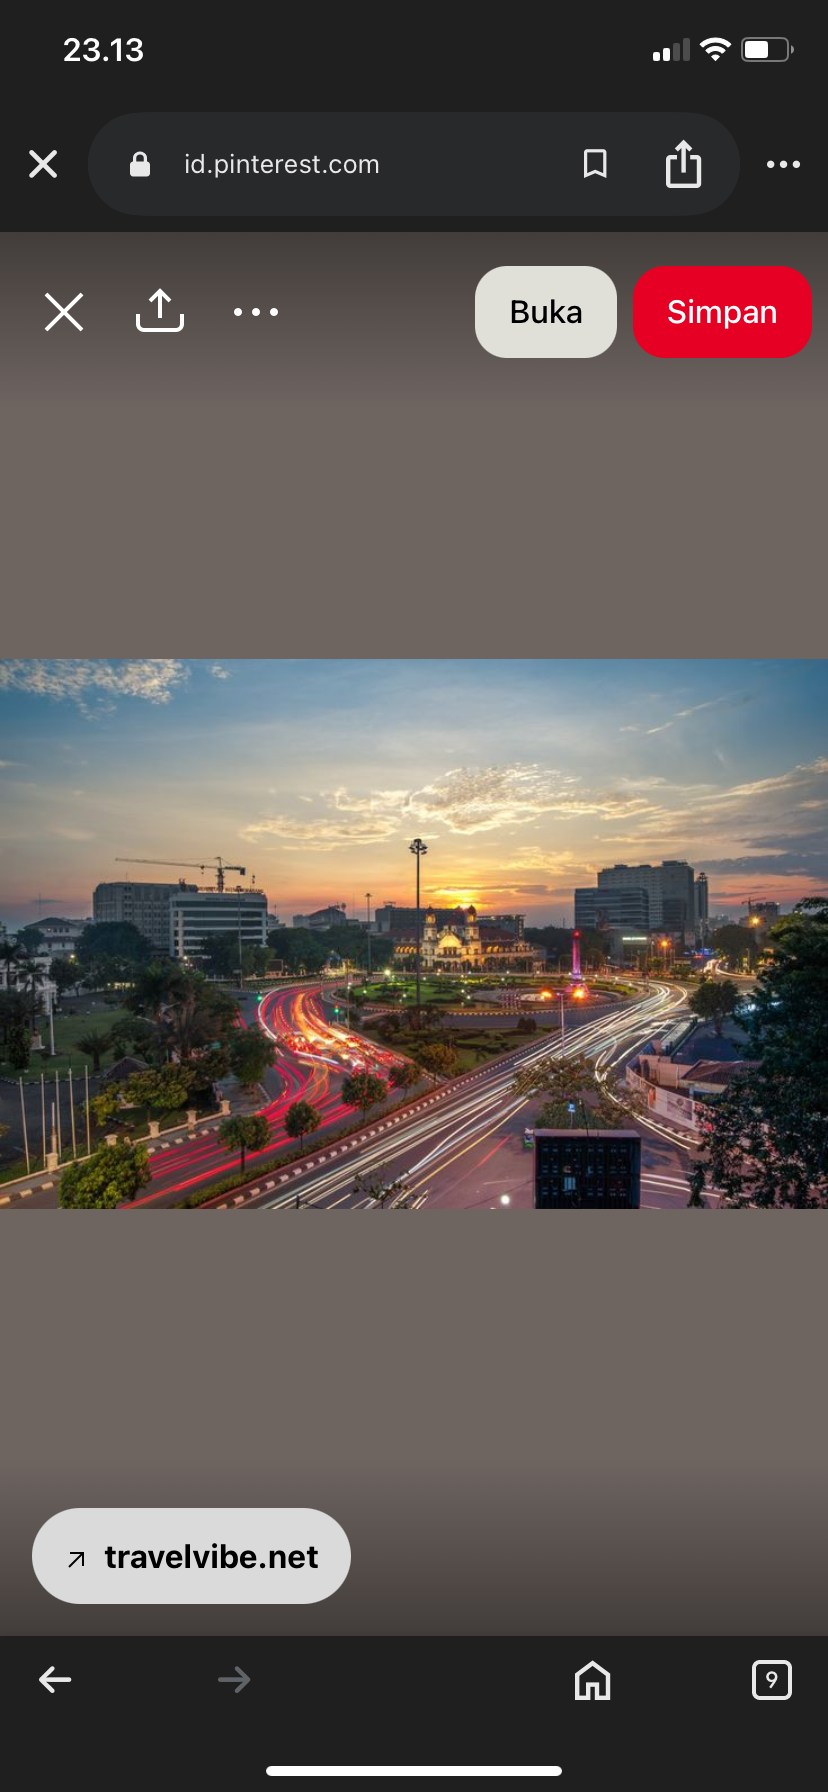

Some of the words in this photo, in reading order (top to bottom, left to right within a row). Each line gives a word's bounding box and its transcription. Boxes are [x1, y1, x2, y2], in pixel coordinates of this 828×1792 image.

[64, 38, 143, 62] 23.13
[186, 154, 378, 178] id.pinterest.com
[512, 299, 581, 323] Buka
[668, 299, 776, 329] Simpan
[105, 1543, 318, 1568] travelvibe.net
[766, 1671, 777, 1688] 9
